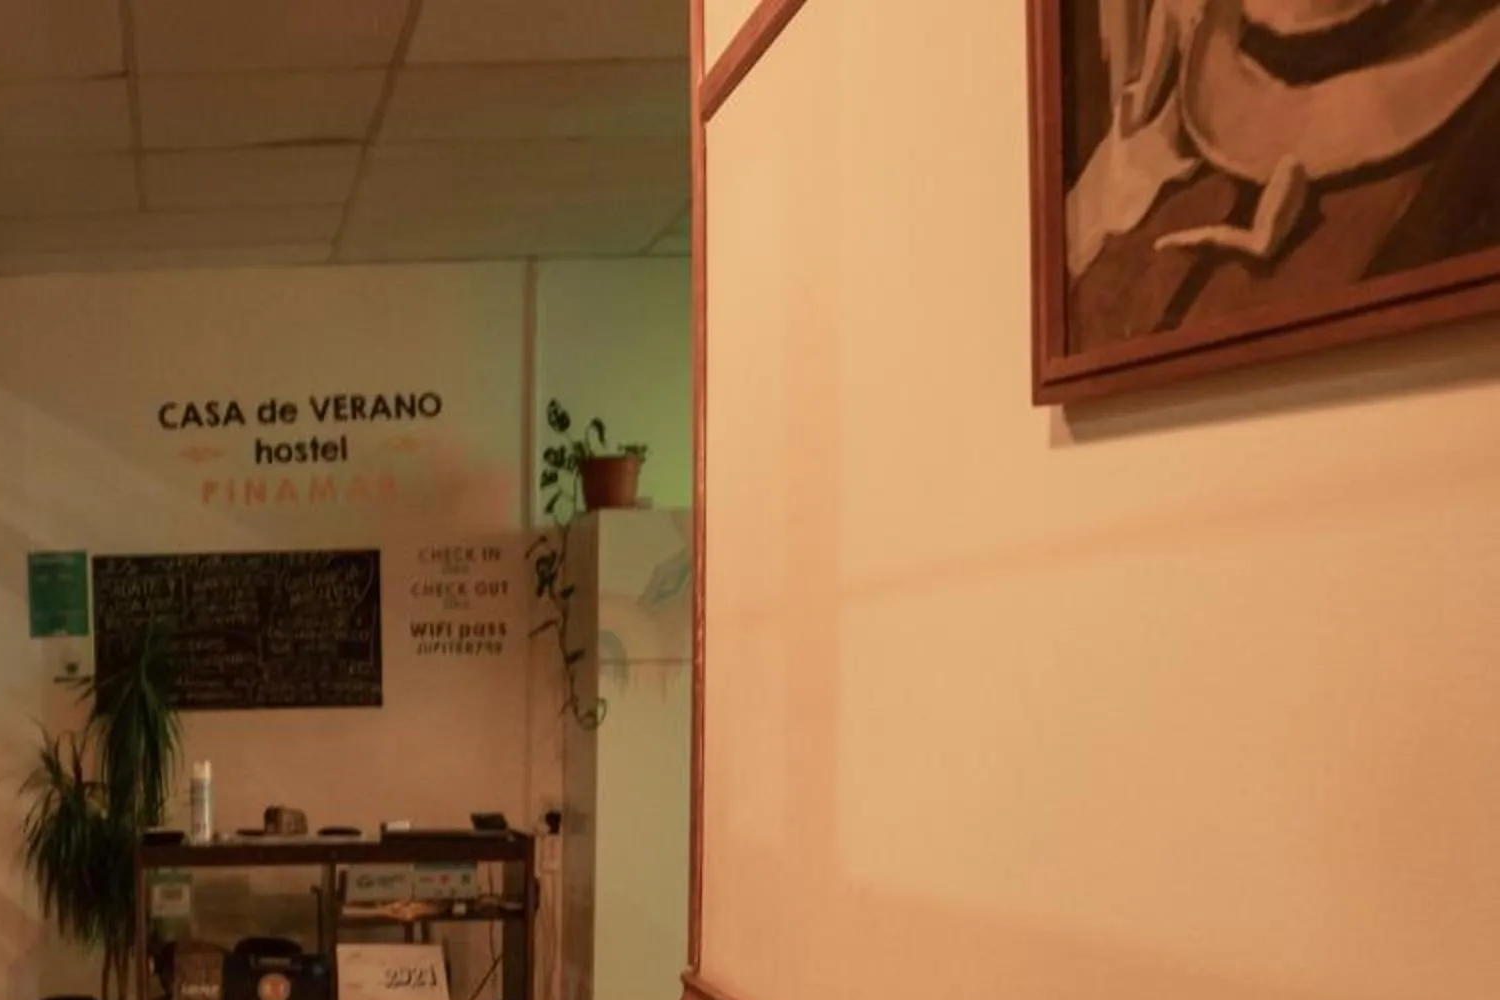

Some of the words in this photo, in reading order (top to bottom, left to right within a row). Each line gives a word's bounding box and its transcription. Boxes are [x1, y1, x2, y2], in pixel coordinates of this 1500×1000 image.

[157, 400, 246, 430] CASA
[257, 397, 298, 424] de
[309, 391, 443, 422] VERANO
[255, 435, 348, 465] hostel
[200, 475, 398, 505] PINAMAR
[418, 546, 476, 562] CHECK
[482, 547, 502, 561] IN
[474, 580, 509, 598] OUT
